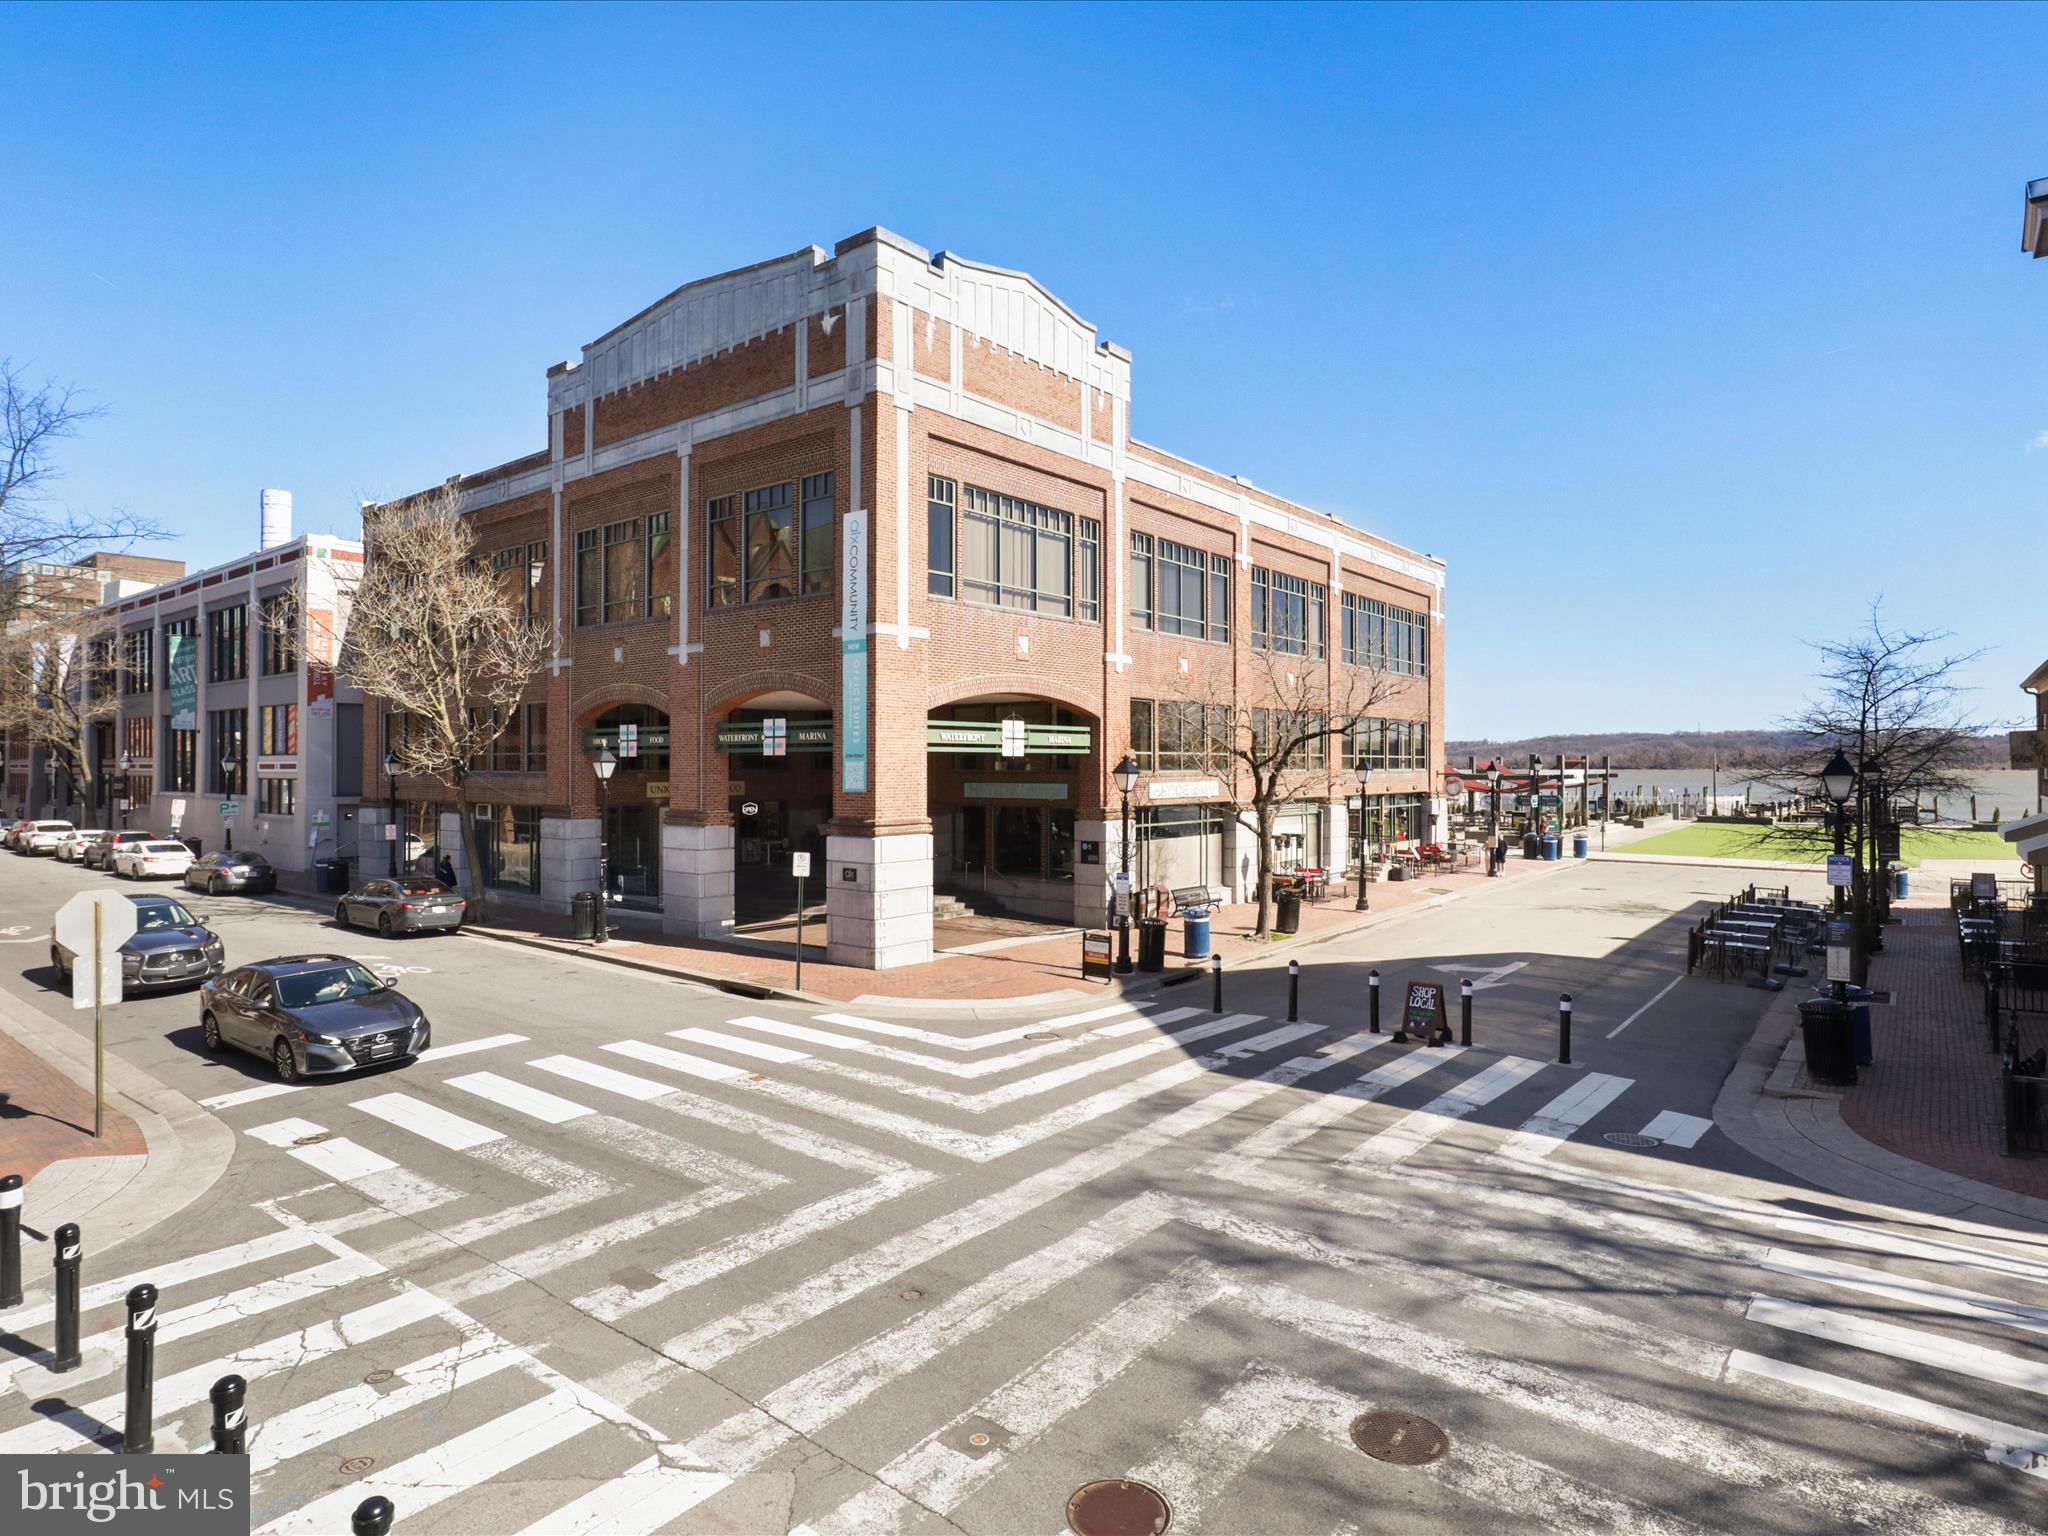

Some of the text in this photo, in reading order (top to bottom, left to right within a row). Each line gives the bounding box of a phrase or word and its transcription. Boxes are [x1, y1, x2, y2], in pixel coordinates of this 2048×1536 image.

[171, 665, 197, 685] ART
[719, 734, 758, 742] WATERFRONT
[799, 732, 826, 740] MARINA
[940, 732, 985, 742] WATERFRONT
[1048, 736, 1072, 744] MARINA
[1411, 985, 1437, 999] SHOP
[1409, 995, 1436, 1010] LOCAL
